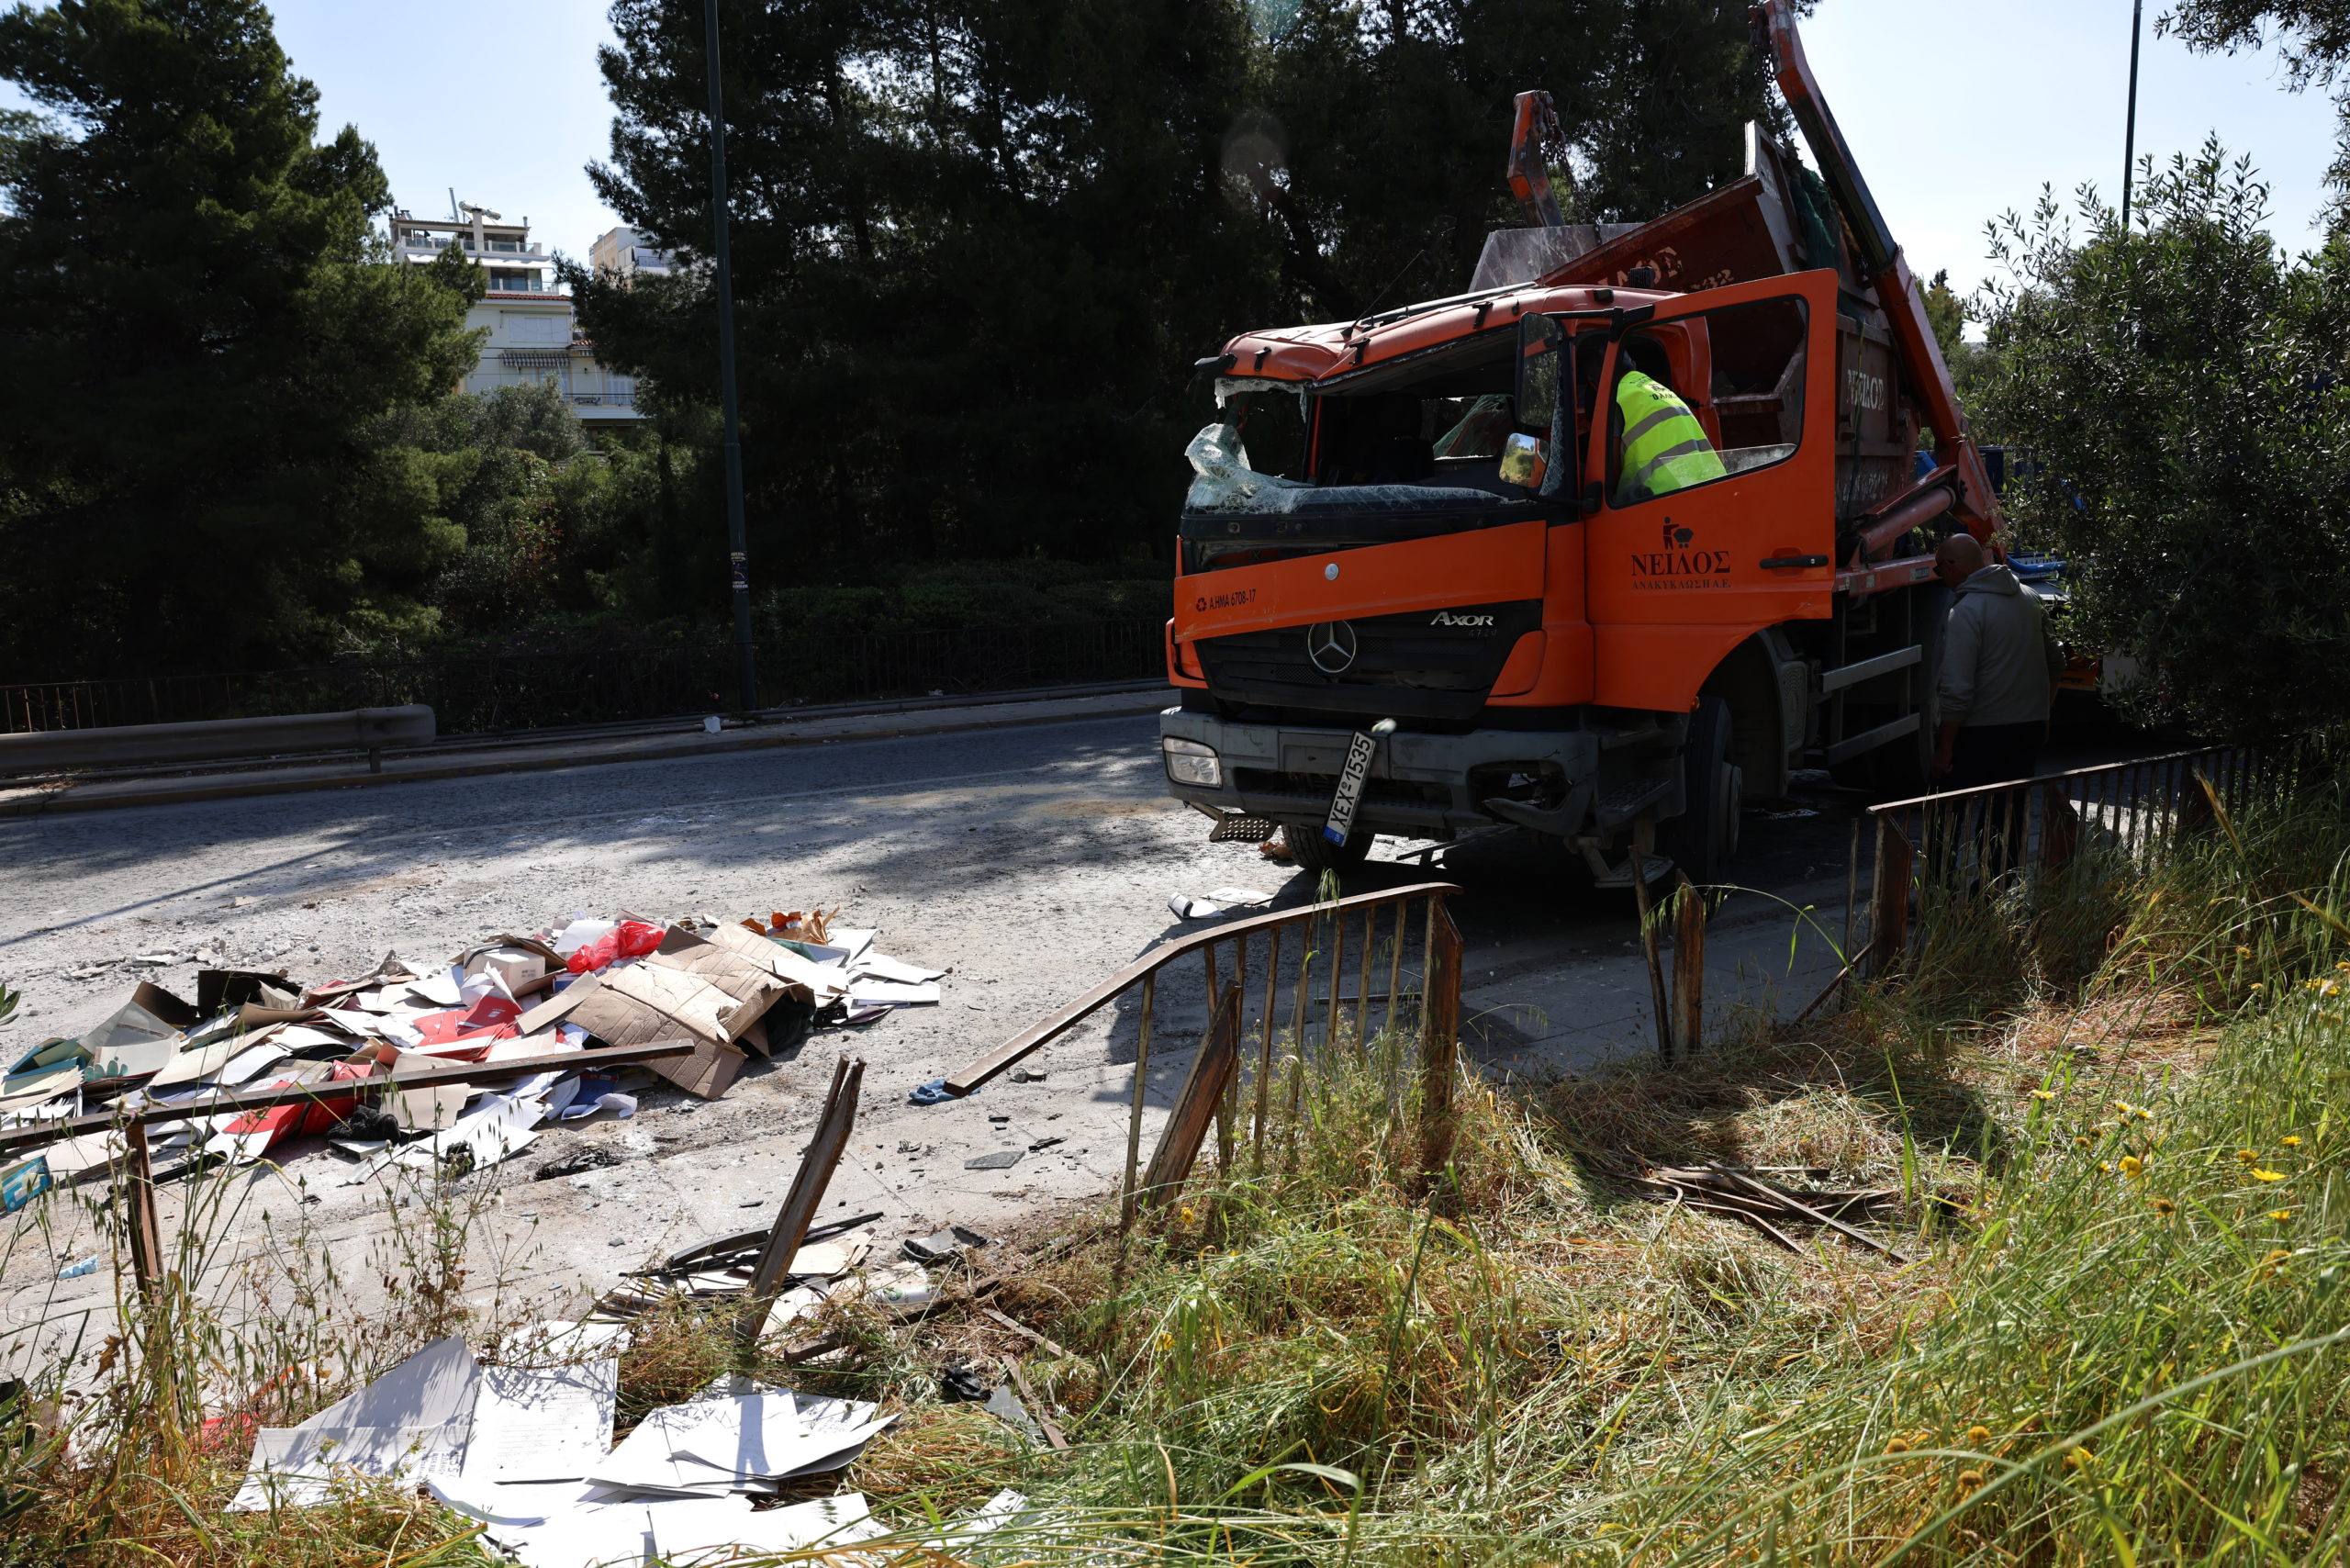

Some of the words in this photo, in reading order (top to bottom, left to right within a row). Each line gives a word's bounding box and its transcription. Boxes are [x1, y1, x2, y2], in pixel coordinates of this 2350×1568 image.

[1631, 550, 1731, 577] ΝΕΙΛΟΣ
[1230, 588, 1257, 606] 6708-17
[1330, 735, 1371, 828] XEX-1535
